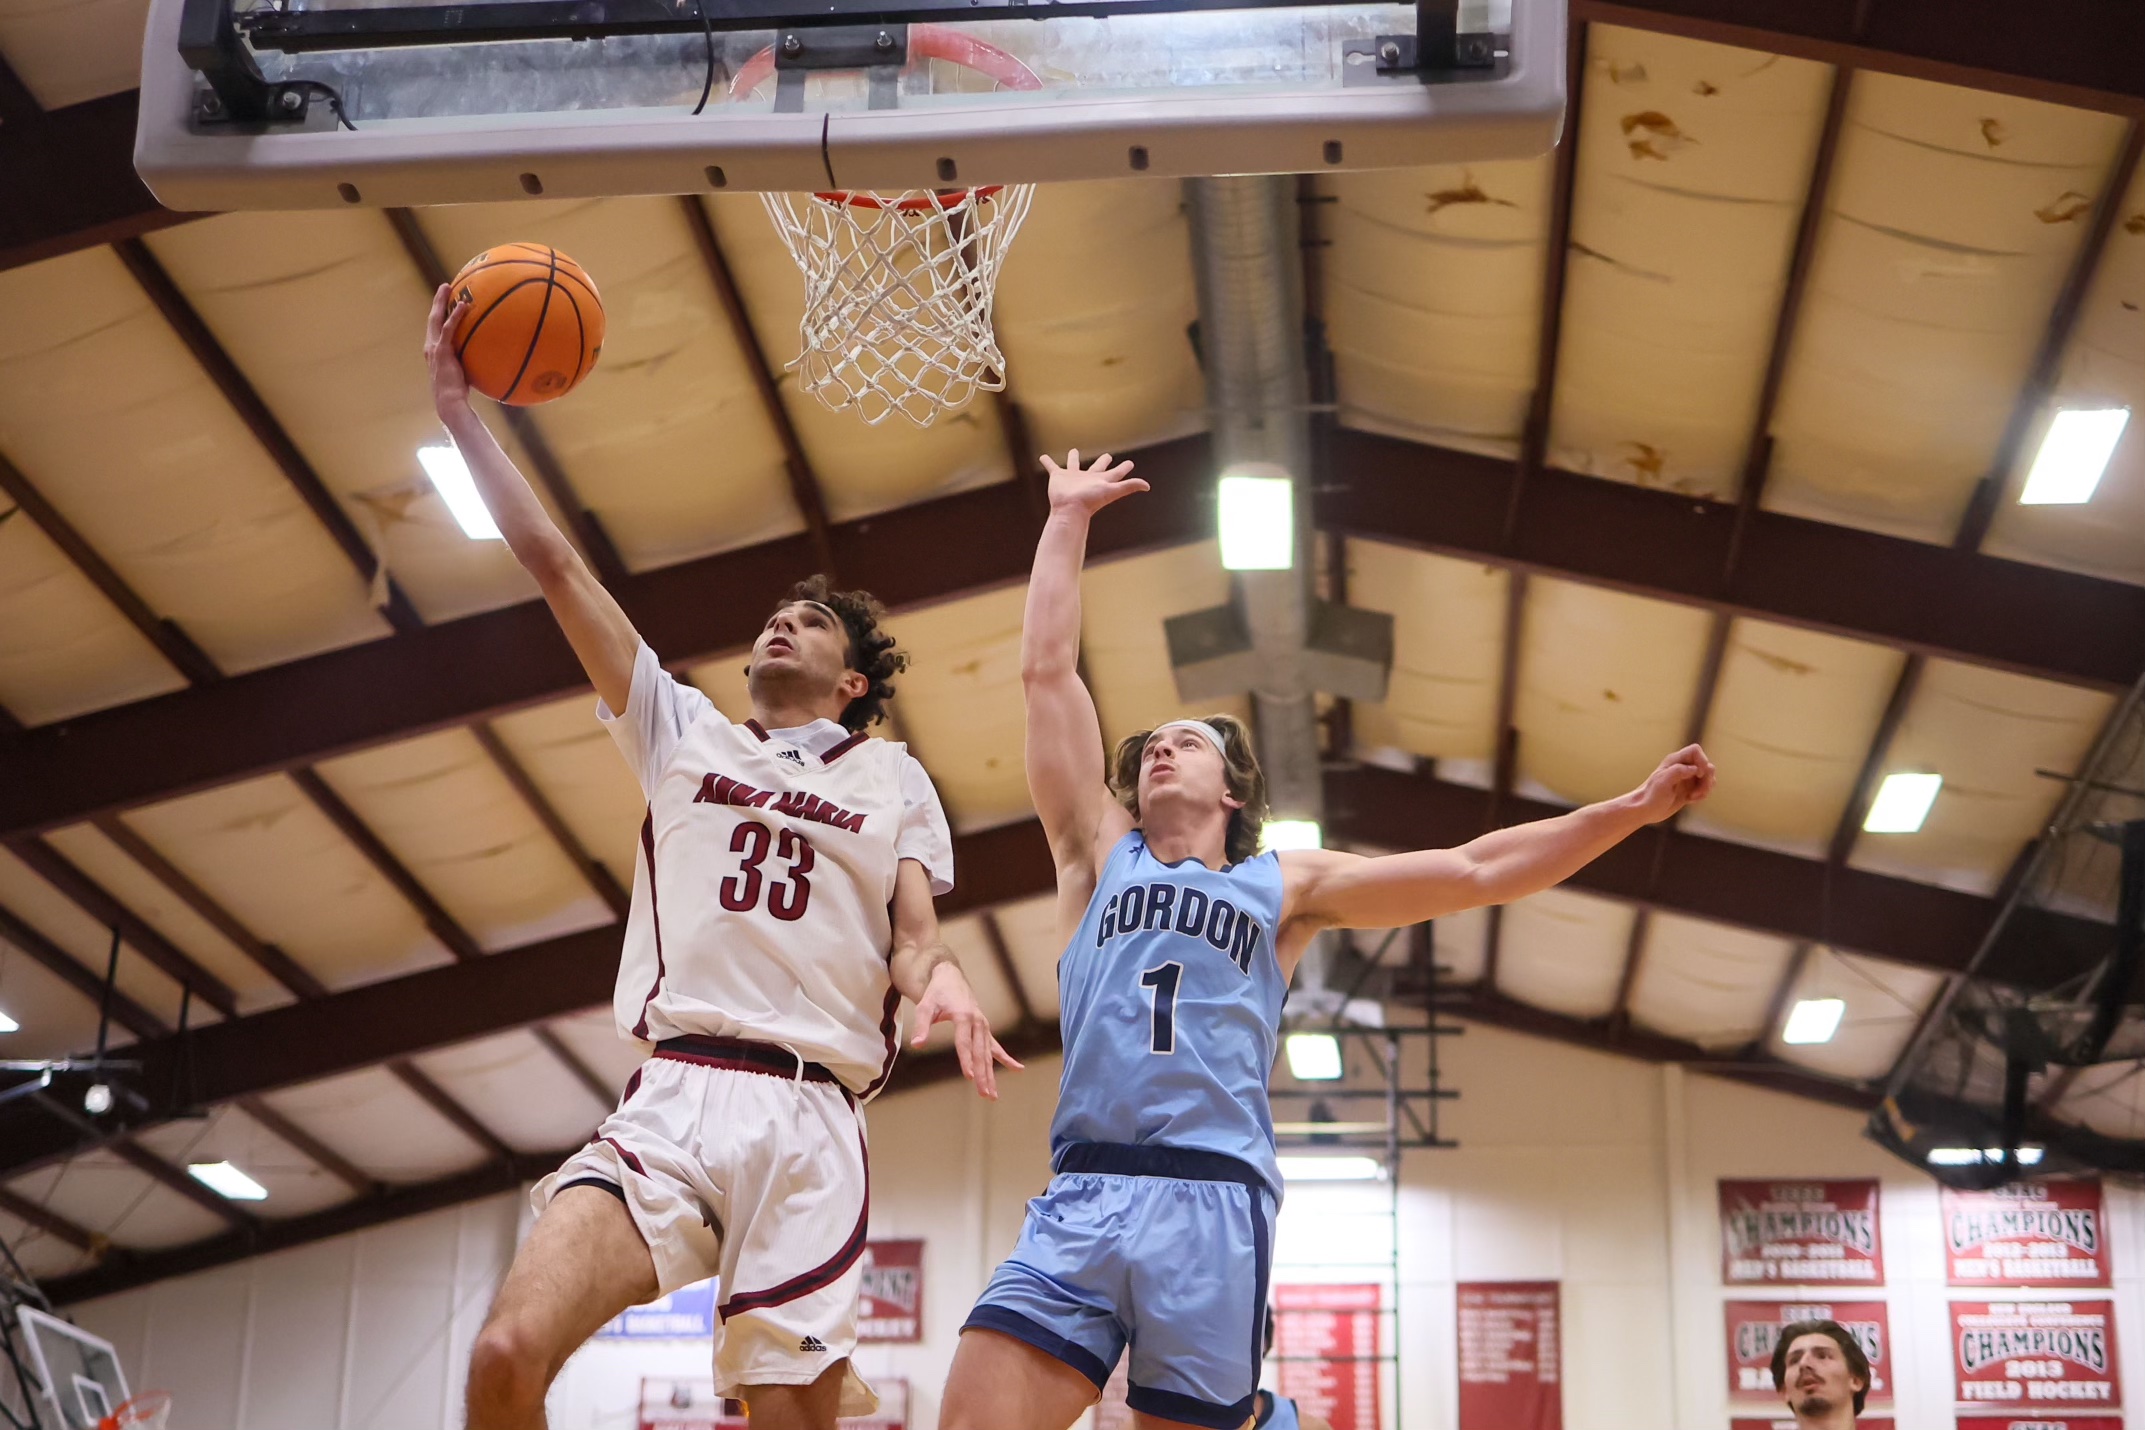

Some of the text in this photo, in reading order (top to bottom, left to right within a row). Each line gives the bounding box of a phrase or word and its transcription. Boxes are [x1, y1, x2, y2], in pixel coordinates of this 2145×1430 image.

[769, 791, 868, 834] MARIA
[719, 821, 815, 921] 33
[1096, 883, 1261, 976] GORDON
[1139, 960, 1184, 1055] 1
[1951, 1209, 2097, 1254] CHAMPIONS
[2002, 1258, 2099, 1278] BASKETBALL
[1960, 1328, 2107, 1373] CHAMPIONS
[1961, 1381, 2112, 1400] FIELD HOCKEY
